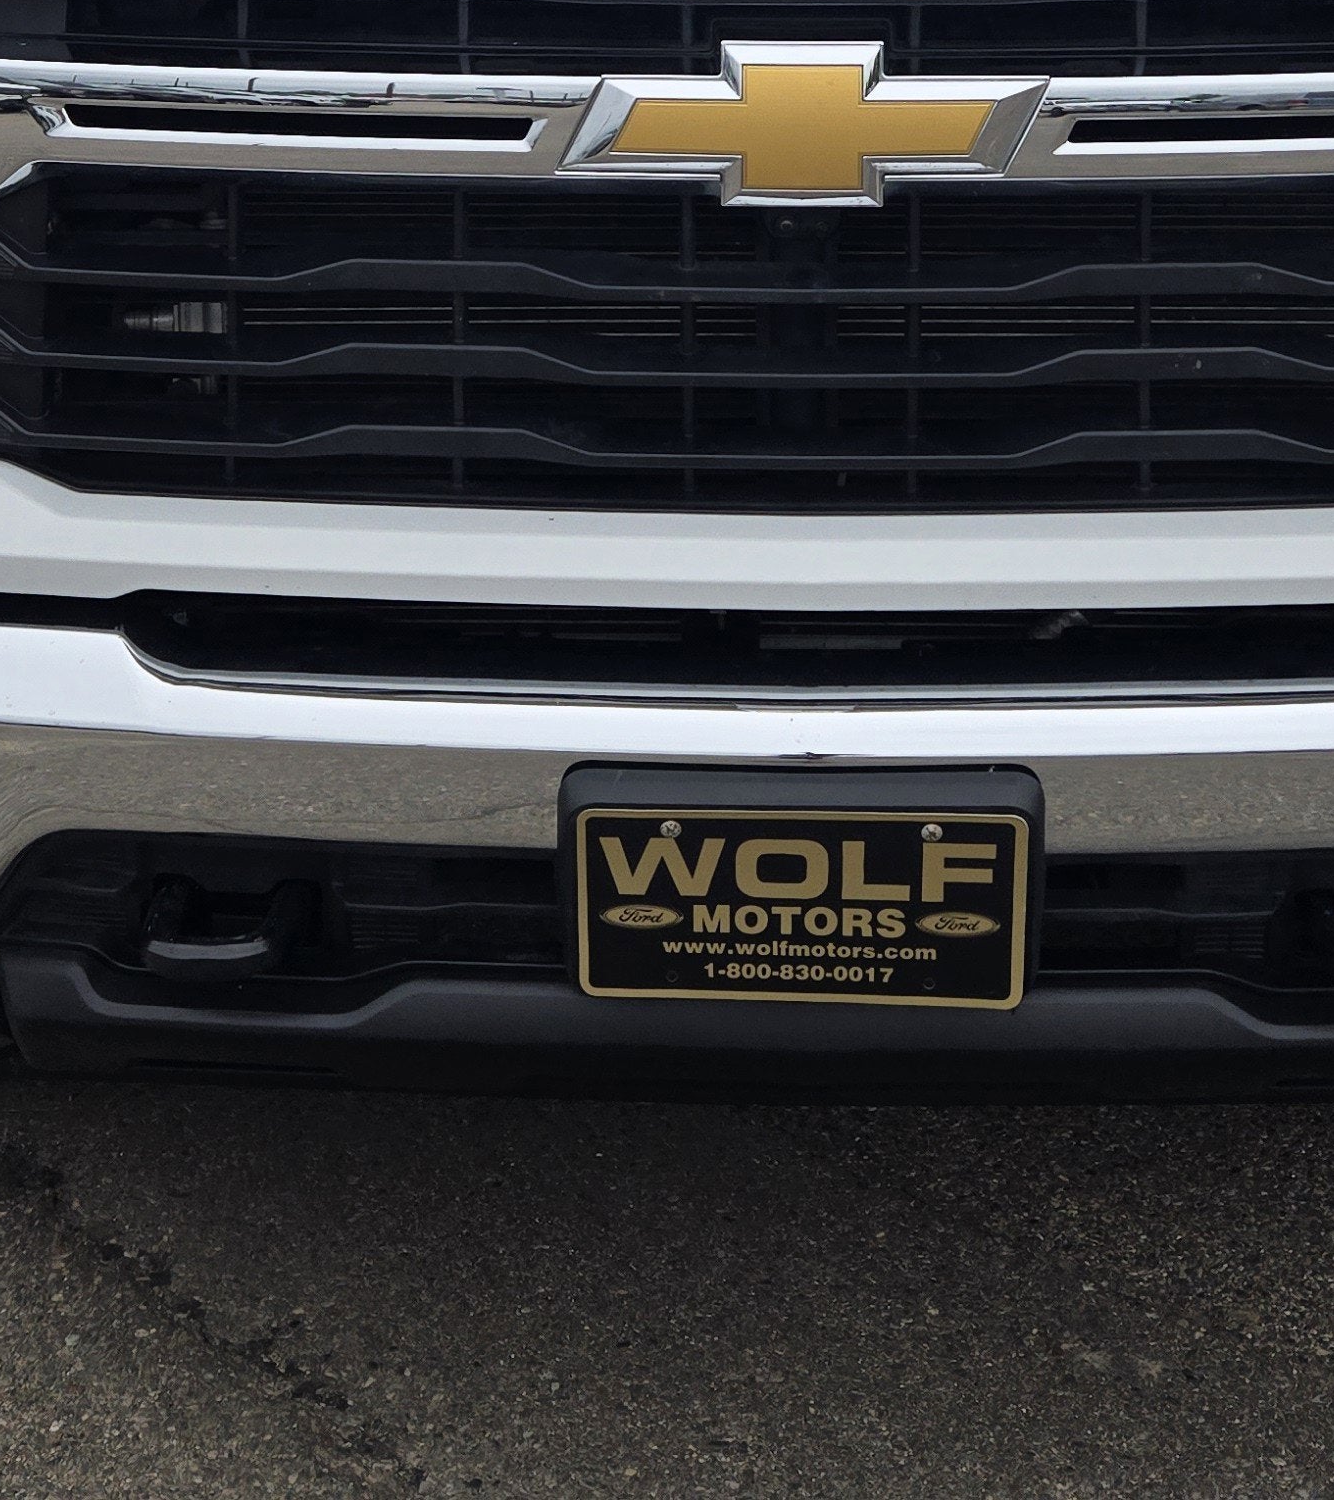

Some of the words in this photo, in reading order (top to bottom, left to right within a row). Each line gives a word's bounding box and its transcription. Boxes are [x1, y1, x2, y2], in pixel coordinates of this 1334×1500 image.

[598, 836, 998, 903] WOLF
[620, 906, 664, 926] Ford
[692, 904, 907, 939] MOTORS
[934, 914, 980, 933] Ford
[662, 939, 938, 961] www.wolfmotors.com
[703, 962, 895, 984] 1-800-830-0017
